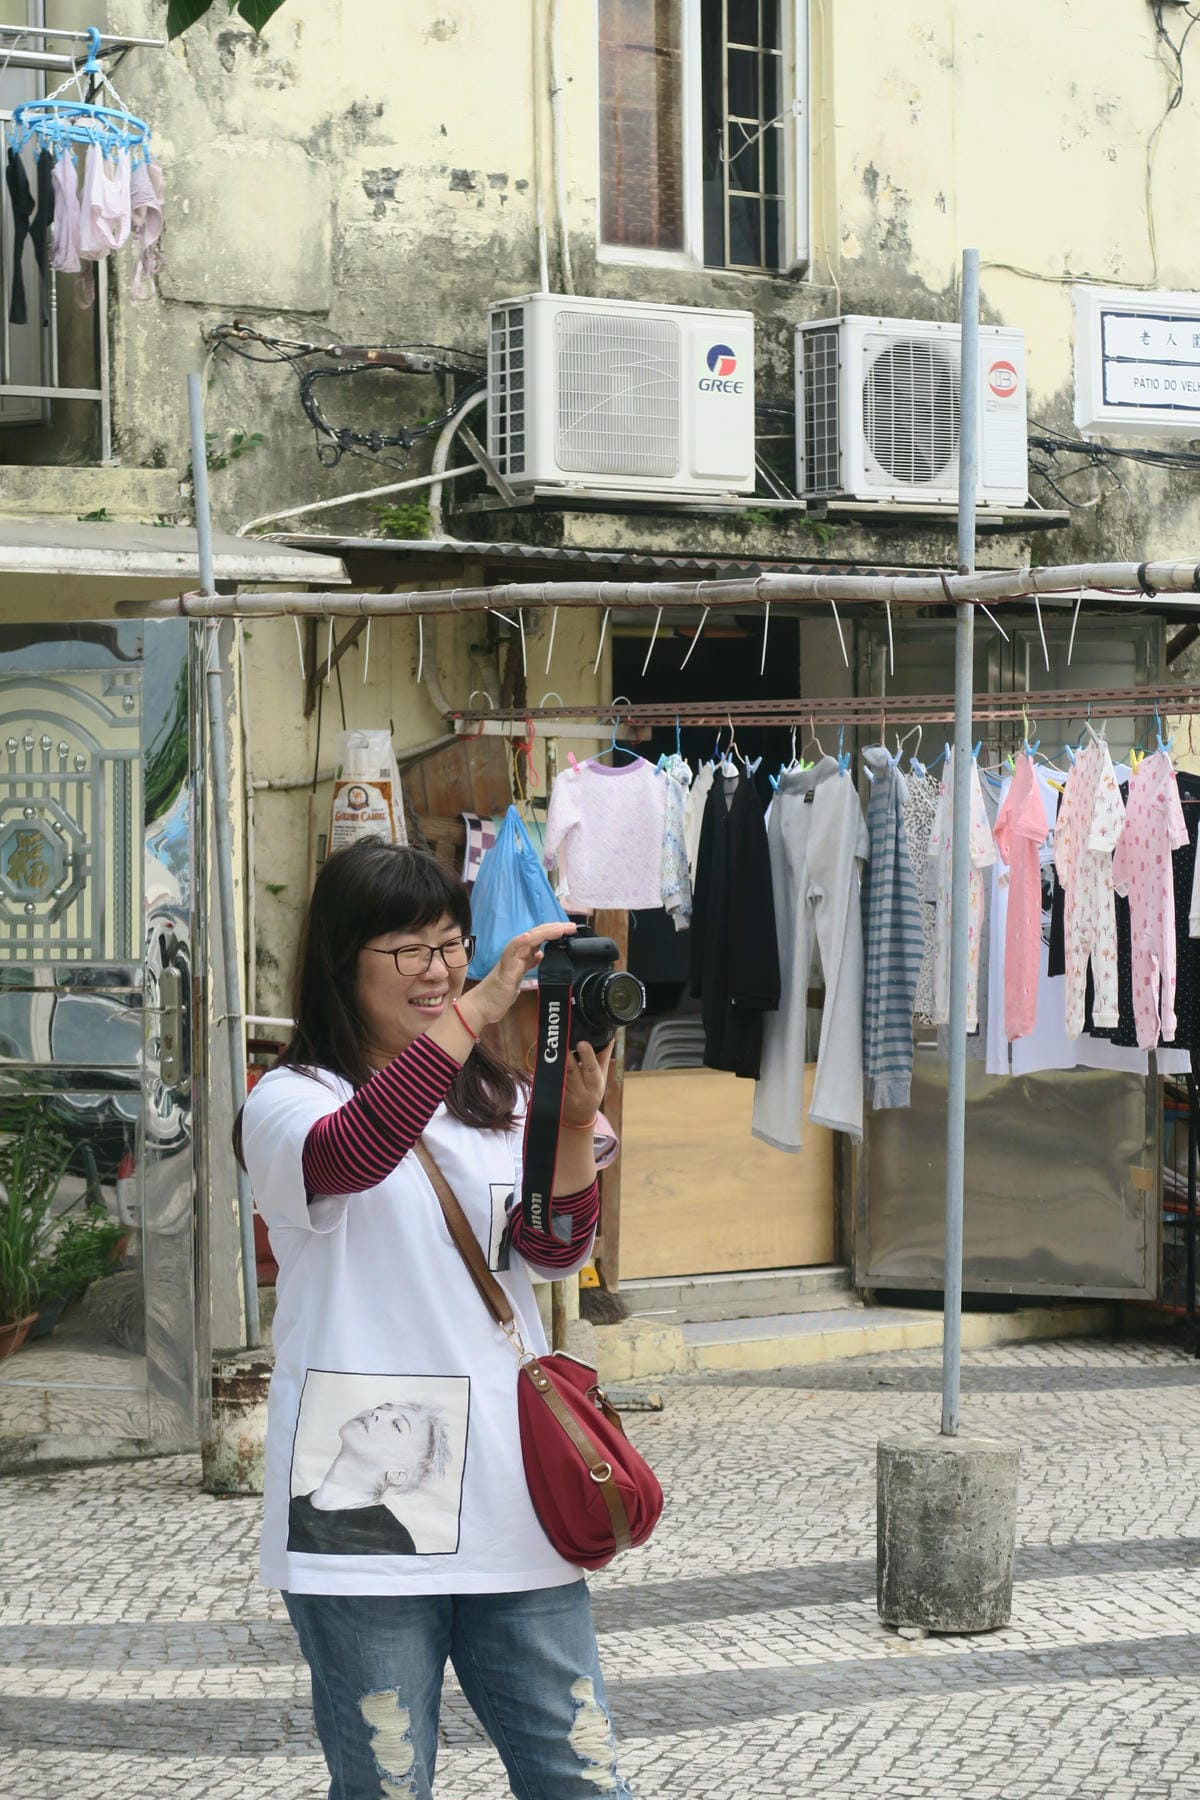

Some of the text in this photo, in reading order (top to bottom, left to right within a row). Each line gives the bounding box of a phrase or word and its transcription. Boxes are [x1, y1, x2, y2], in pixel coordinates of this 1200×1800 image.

[698, 378, 744, 394] GREE
[1164, 379, 1177, 391] DO
[544, 1001, 561, 1064] Canon
